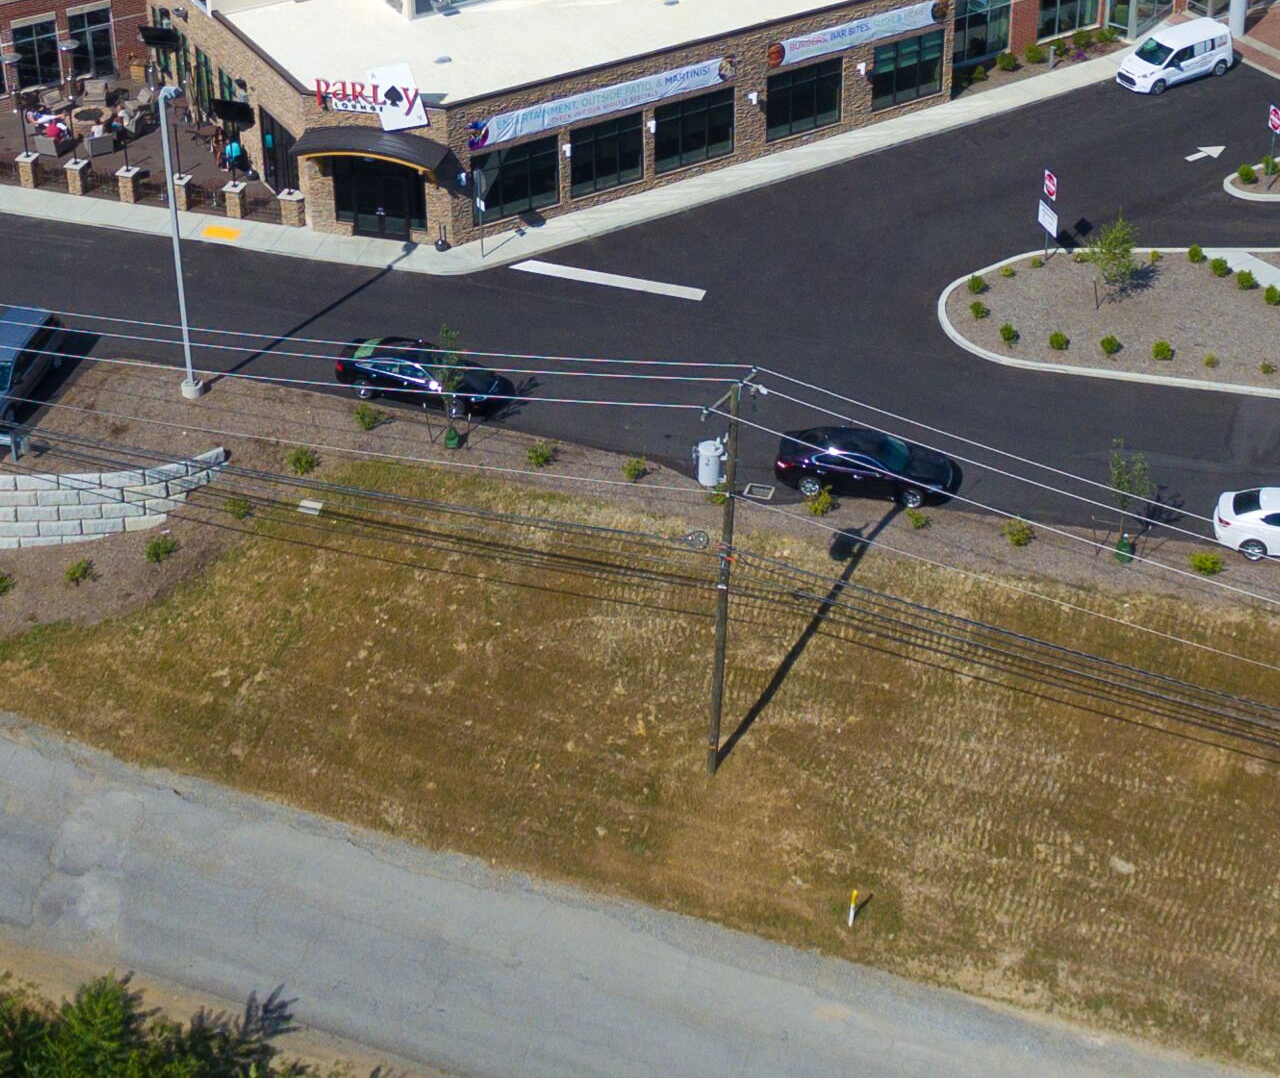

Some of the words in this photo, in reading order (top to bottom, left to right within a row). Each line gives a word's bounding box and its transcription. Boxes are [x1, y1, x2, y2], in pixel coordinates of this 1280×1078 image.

[830, 30, 847, 42] BAR
[497, 103, 579, 130] ENRTAINMENT,
[582, 90, 624, 107] OUTSIDE
[664, 67, 710, 85] MARTINIS!
